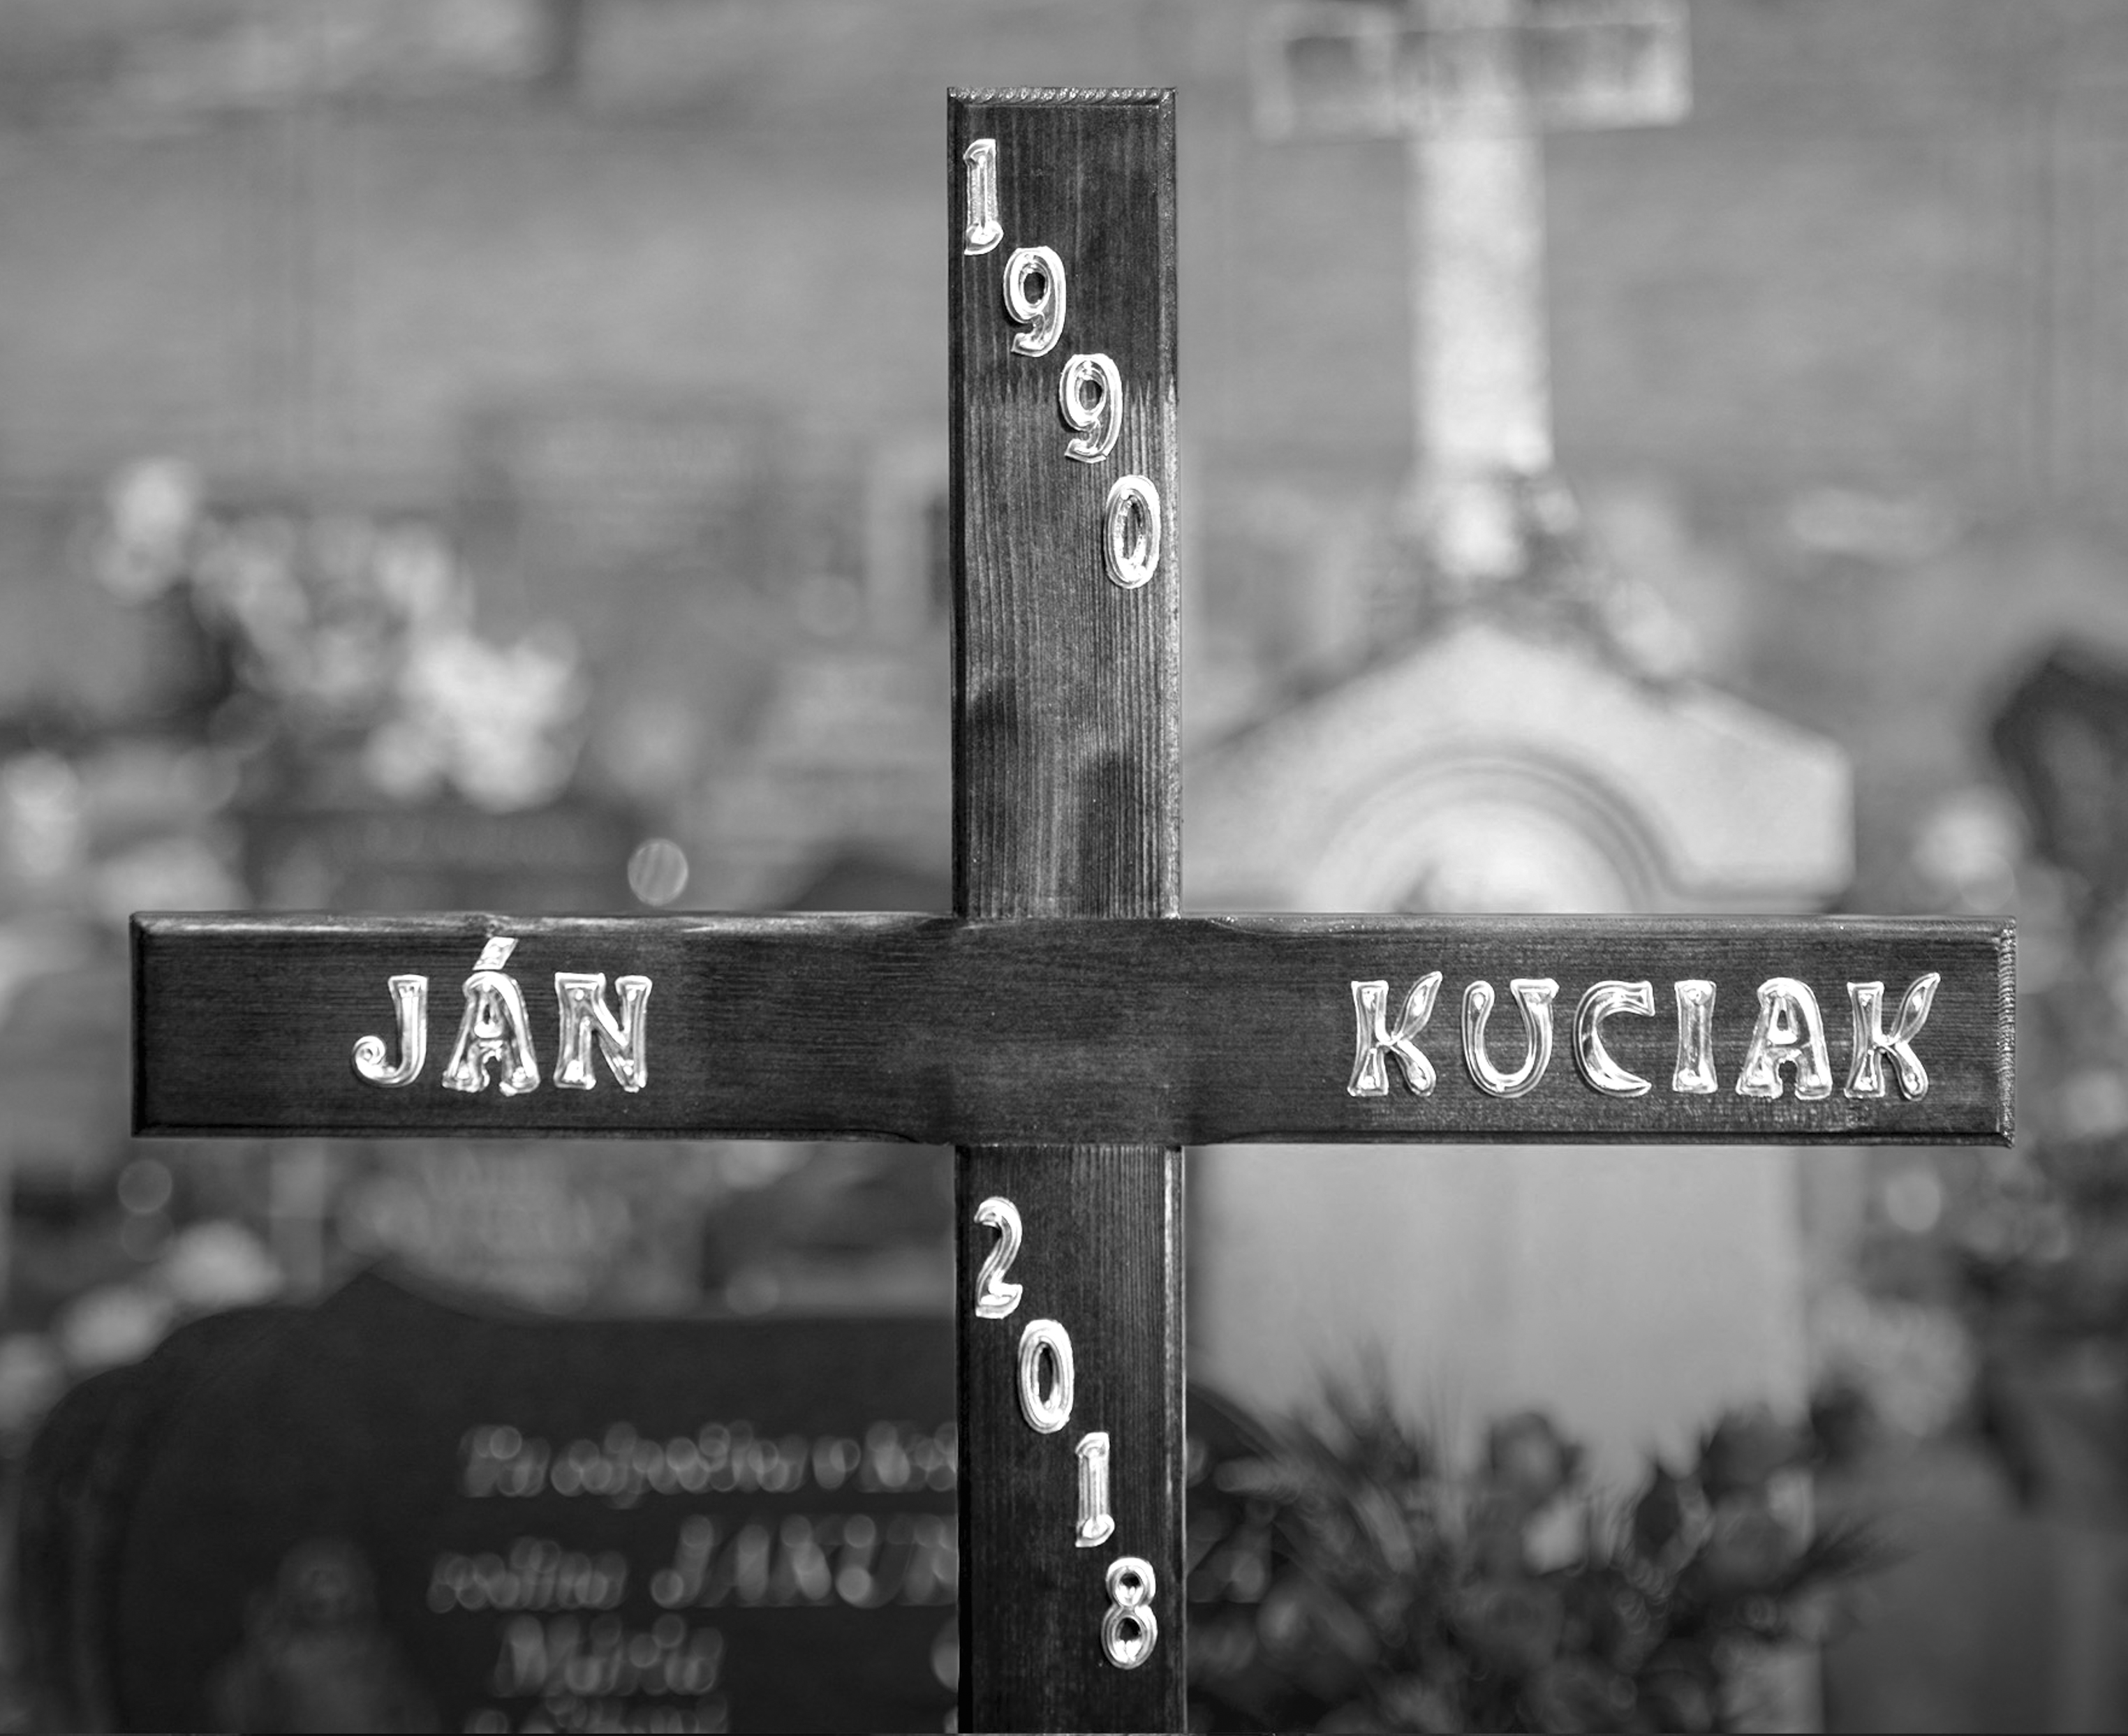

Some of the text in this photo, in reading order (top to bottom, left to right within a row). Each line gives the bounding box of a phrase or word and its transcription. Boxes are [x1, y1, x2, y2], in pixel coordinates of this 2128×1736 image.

[963, 138, 1162, 591] 1990
[352, 933, 1942, 1101] JÁN KUCIAK
[974, 1196, 1159, 1670] 2018
